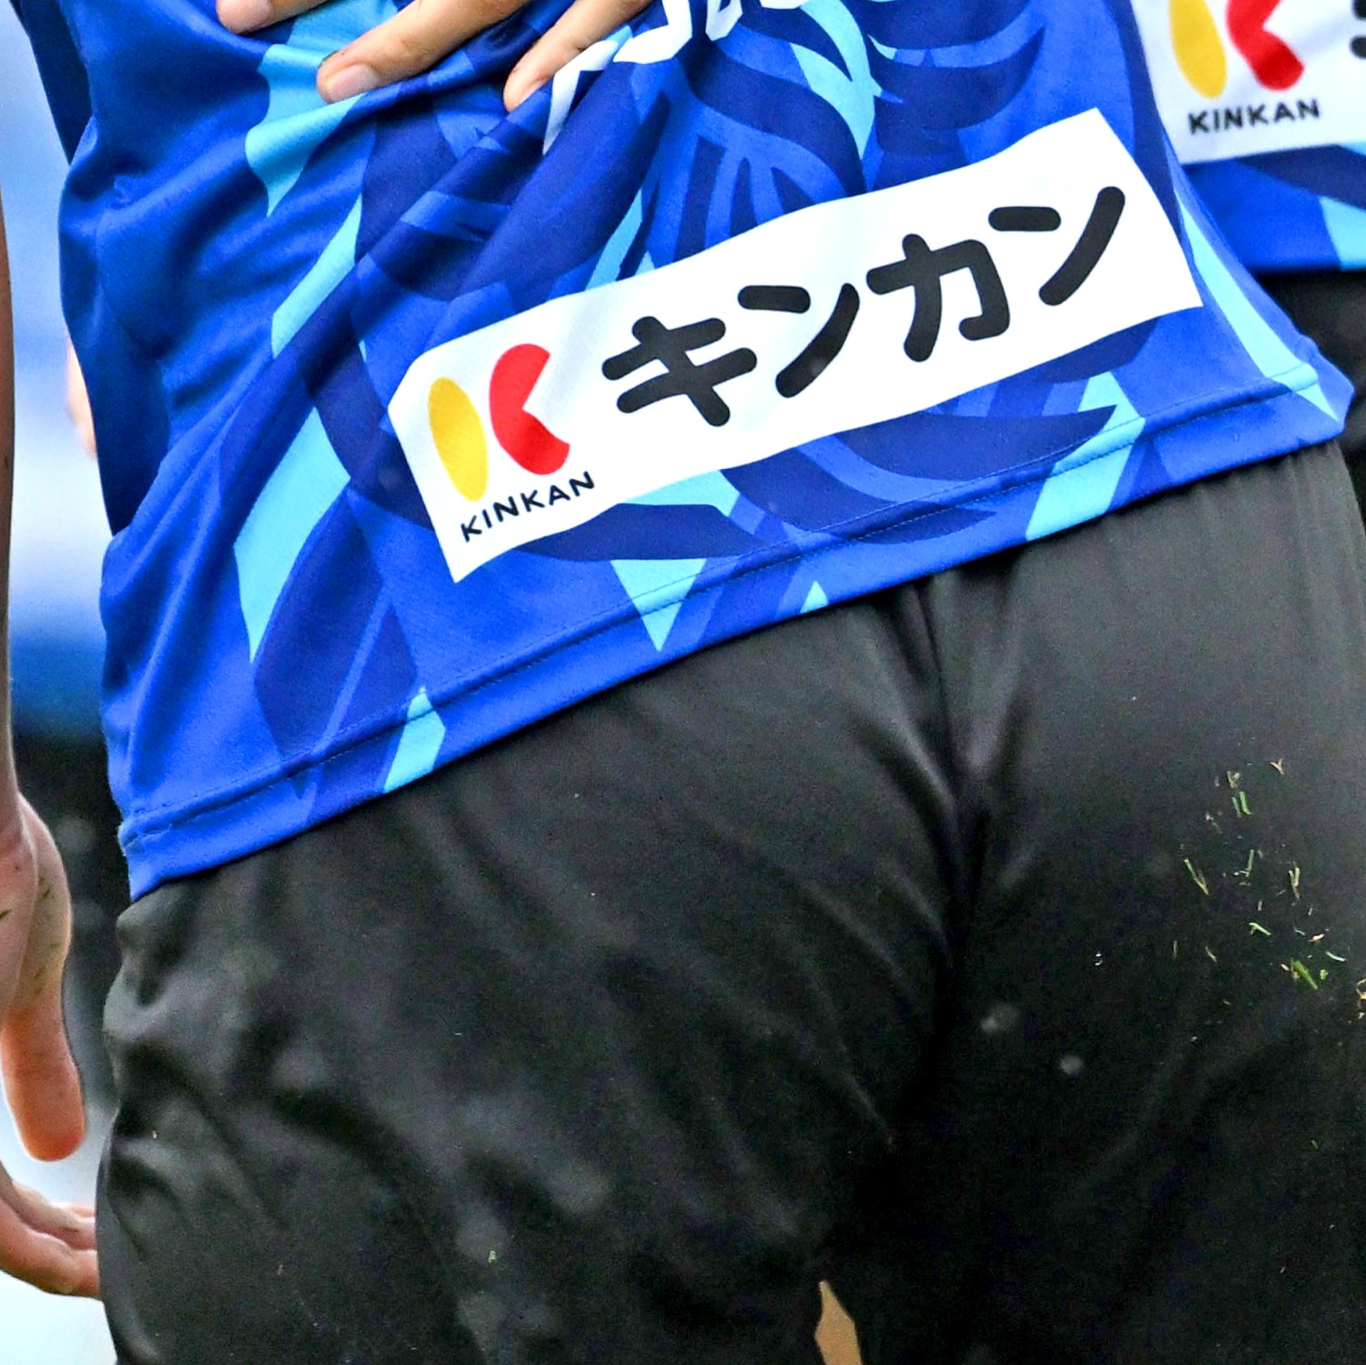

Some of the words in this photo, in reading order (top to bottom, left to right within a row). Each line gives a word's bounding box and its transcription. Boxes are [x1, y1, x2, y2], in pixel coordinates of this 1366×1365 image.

[1187, 99, 1321, 135] KINKAN
[602, 186, 1125, 427] キンカン
[461, 471, 595, 542] KINKAN
